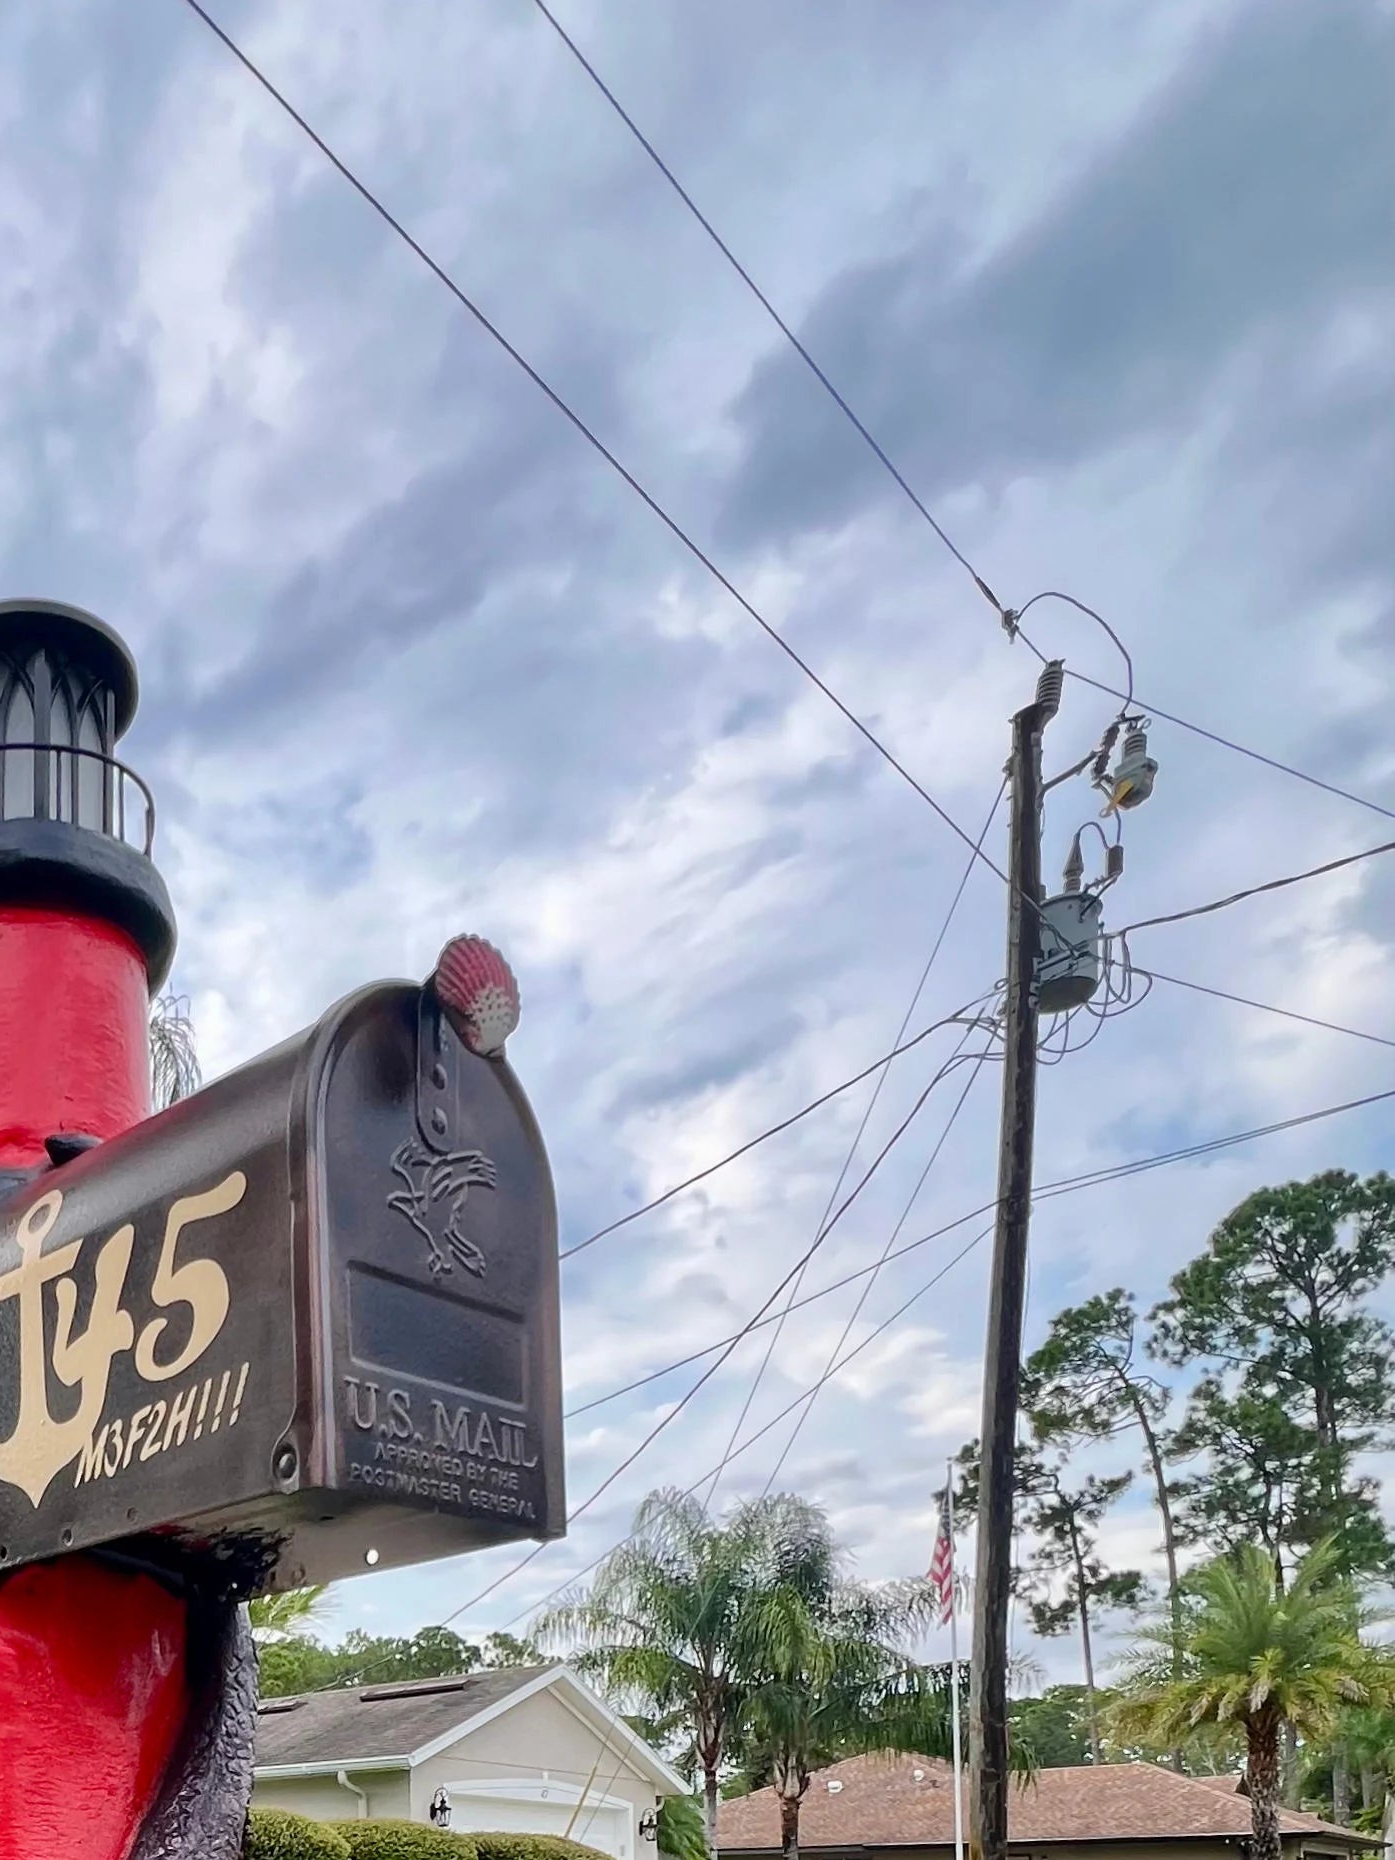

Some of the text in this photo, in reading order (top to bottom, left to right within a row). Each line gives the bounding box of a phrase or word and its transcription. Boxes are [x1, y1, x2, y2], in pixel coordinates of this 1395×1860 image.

[74, 1362, 250, 1488] M3F2H!!!
[344, 1376, 538, 1468] U.S. MAIL
[349, 1462, 537, 1519] POSTMASTER GENERAL
[374, 1441, 519, 1491] APPROVED BY THE
